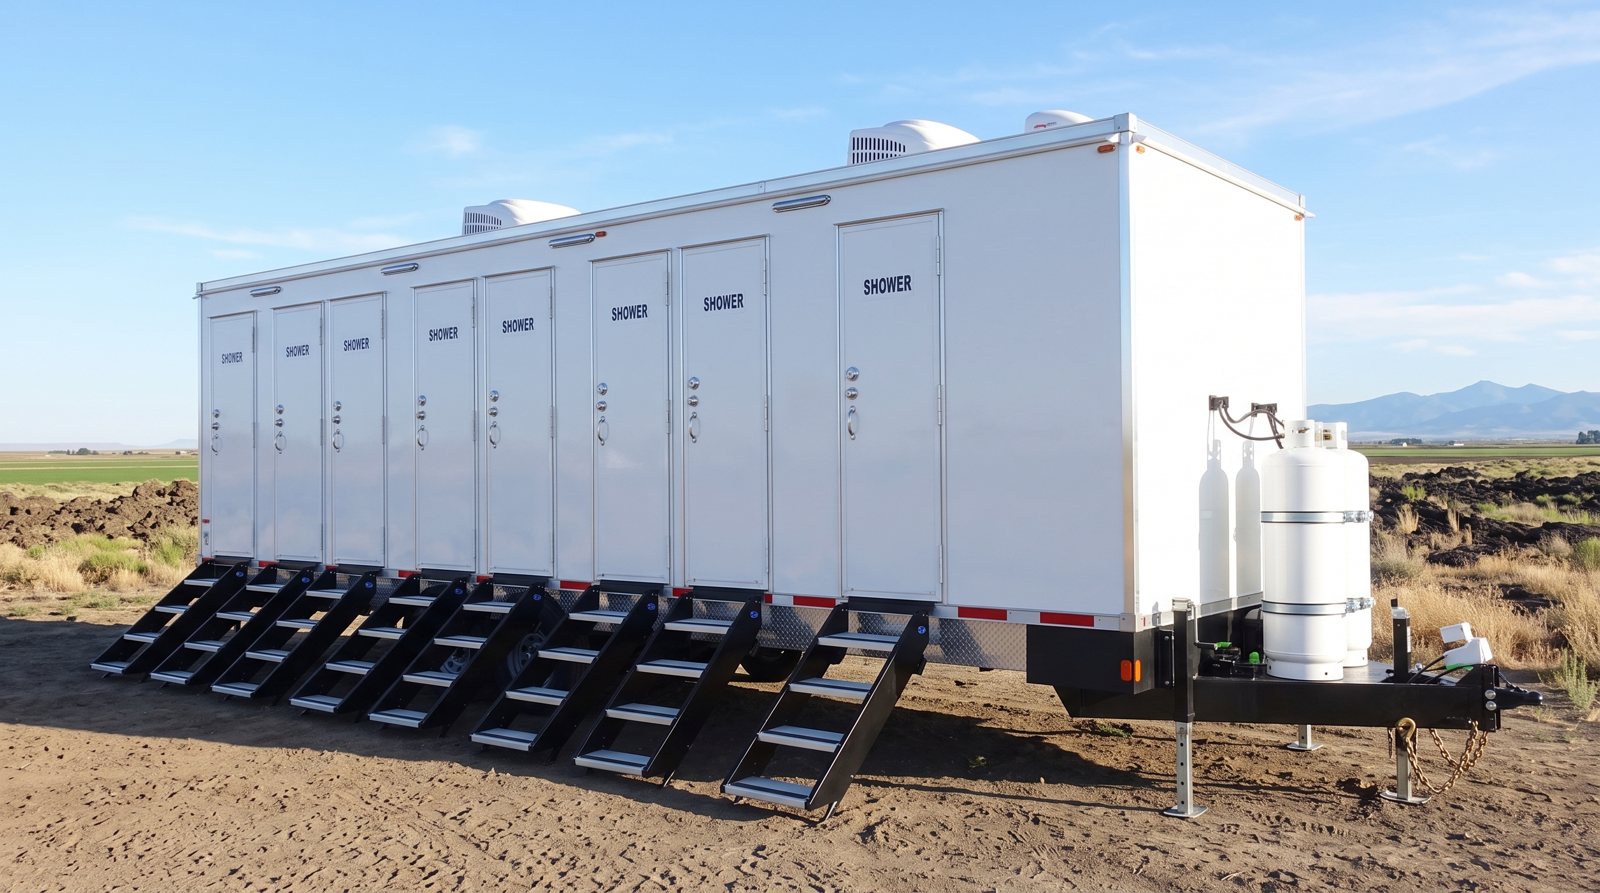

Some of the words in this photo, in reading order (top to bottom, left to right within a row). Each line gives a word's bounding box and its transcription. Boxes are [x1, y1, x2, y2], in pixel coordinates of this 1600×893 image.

[863, 274, 912, 295] SHOWER
[703, 293, 744, 311] SHOWER
[611, 303, 648, 321] SHOWER
[502, 317, 534, 333] SHOWER
[429, 326, 458, 341] SHOWER
[286, 345, 309, 357] SHOWER
[344, 337, 369, 351] SHOWER
[221, 352, 242, 364] SHOWER
